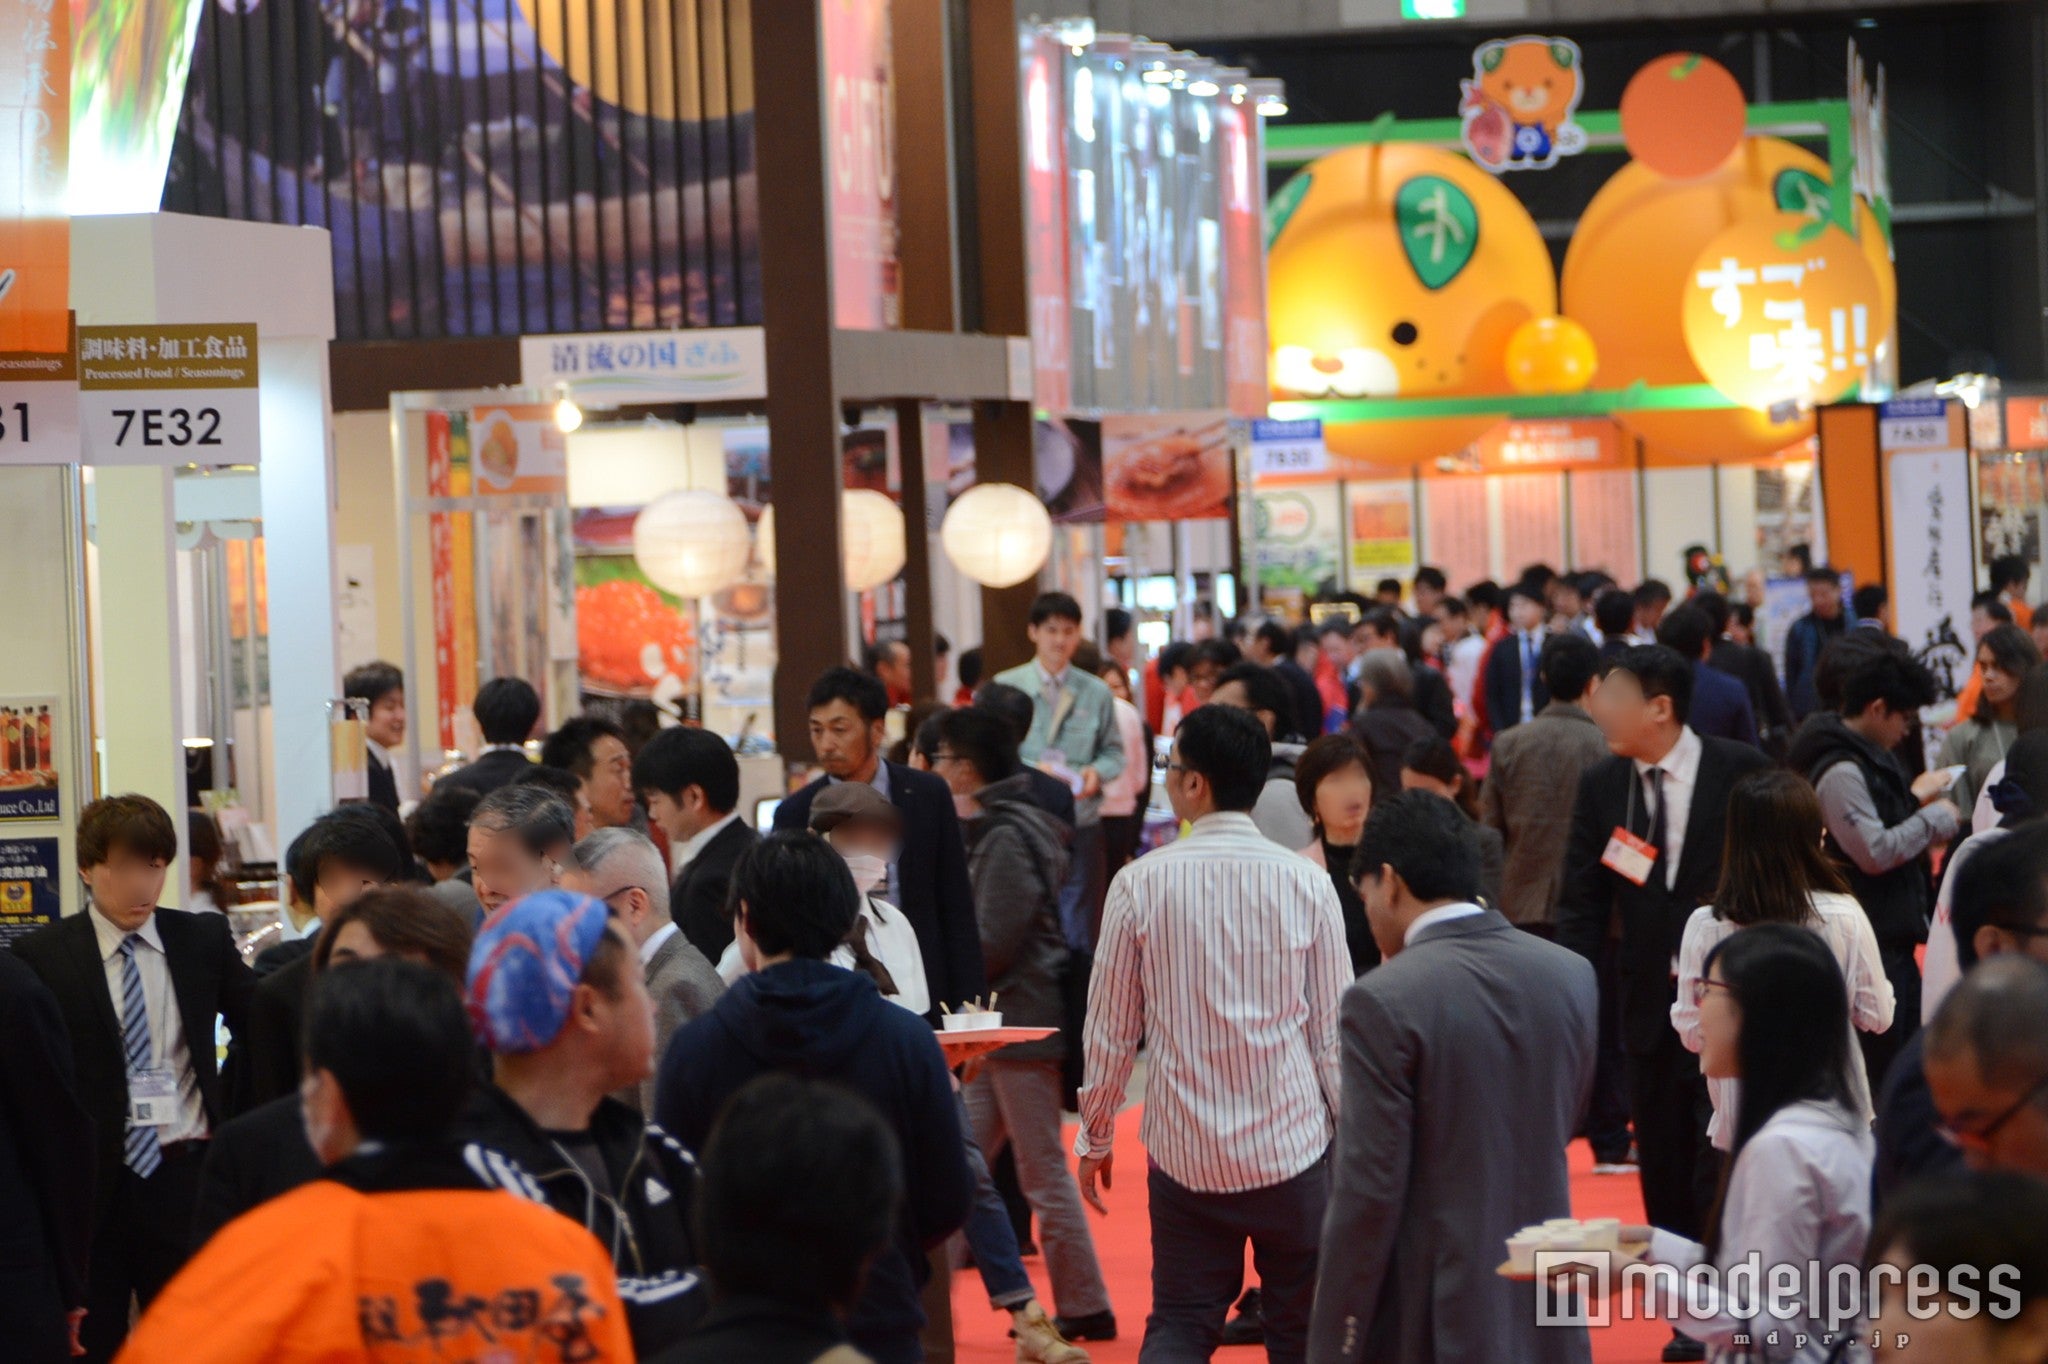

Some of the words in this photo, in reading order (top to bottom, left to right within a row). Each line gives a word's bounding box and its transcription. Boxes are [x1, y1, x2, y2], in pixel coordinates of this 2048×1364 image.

[0, 357, 64, 371] easonings
[84, 367, 142, 380] Processed
[144, 366, 173, 379] Food
[181, 365, 246, 381] Seasonings
[0, 401, 30, 443] 1
[111, 407, 222, 447] 7E32
